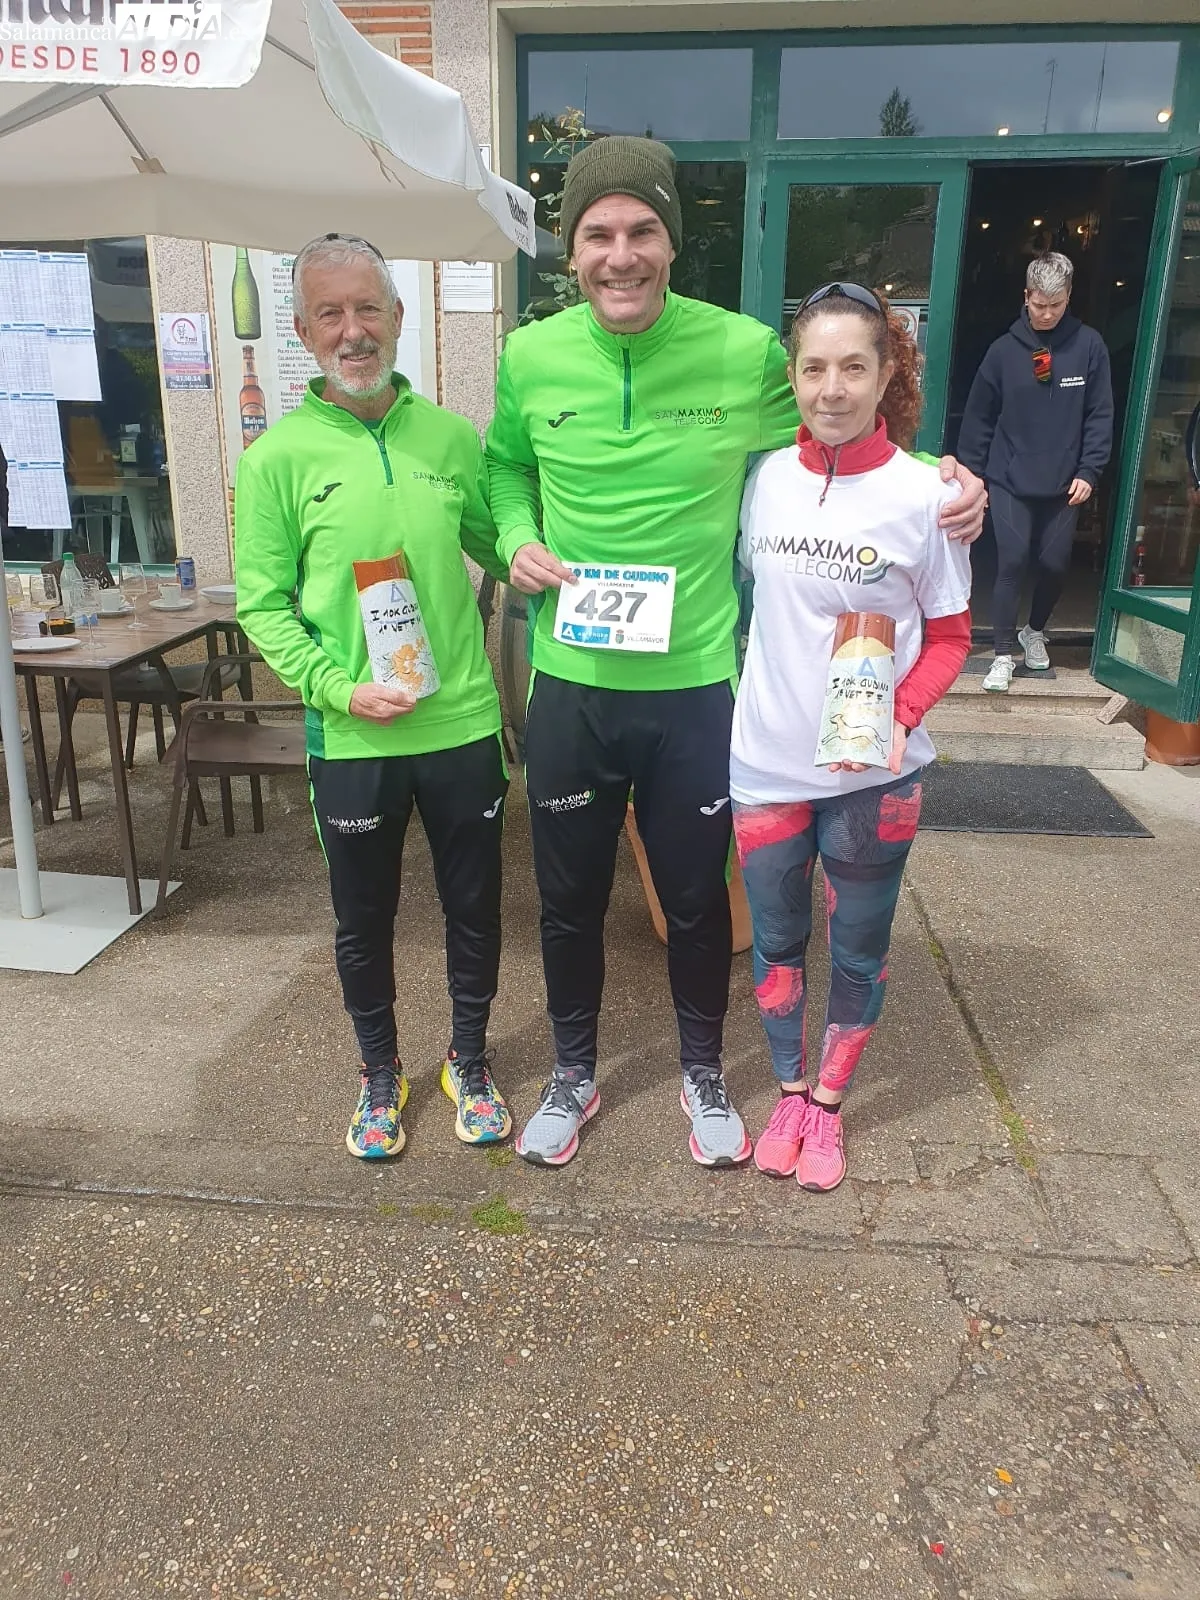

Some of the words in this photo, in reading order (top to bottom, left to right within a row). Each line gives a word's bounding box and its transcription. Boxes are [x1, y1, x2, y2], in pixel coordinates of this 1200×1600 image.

[0, 44, 98, 72] ESDE
[119, 48, 201, 75] 1890
[655, 407, 722, 420] SANMAXIMO
[749, 535, 878, 567] SANMAXIMO
[584, 568, 601, 580] KM
[604, 569, 620, 580] DE
[784, 556, 862, 585] ELECOM
[574, 589, 648, 624] 427
